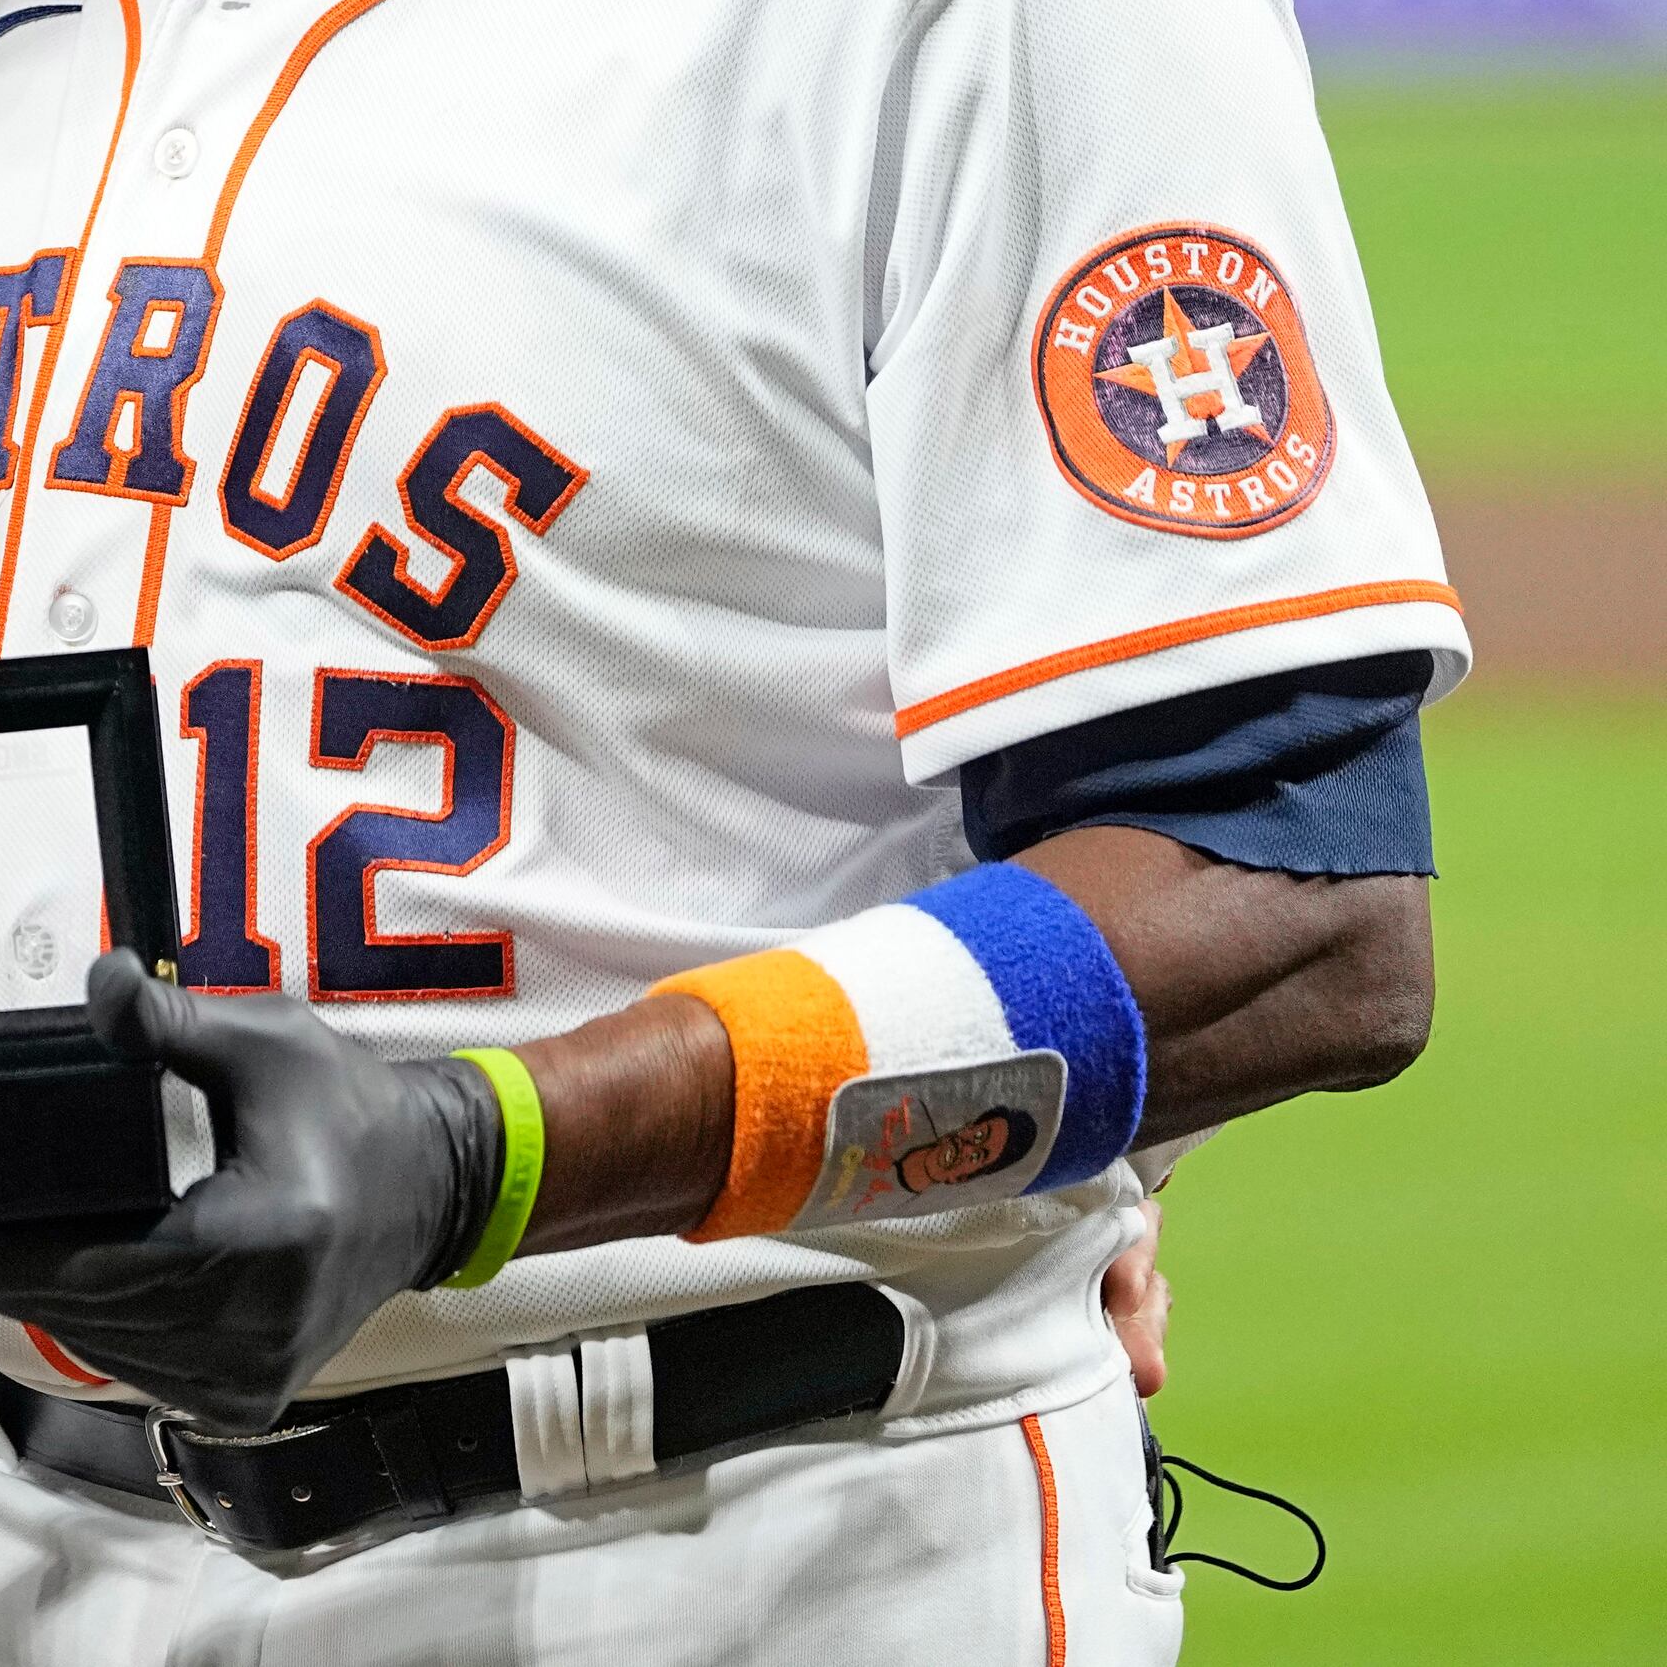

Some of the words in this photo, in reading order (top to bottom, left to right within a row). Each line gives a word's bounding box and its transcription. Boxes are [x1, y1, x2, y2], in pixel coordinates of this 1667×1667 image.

[1054, 242, 1278, 356] HOUSTON
[1126, 323, 1265, 444] H
[1123, 433, 1317, 517] ASTROS
[179, 657, 517, 1003] 12
